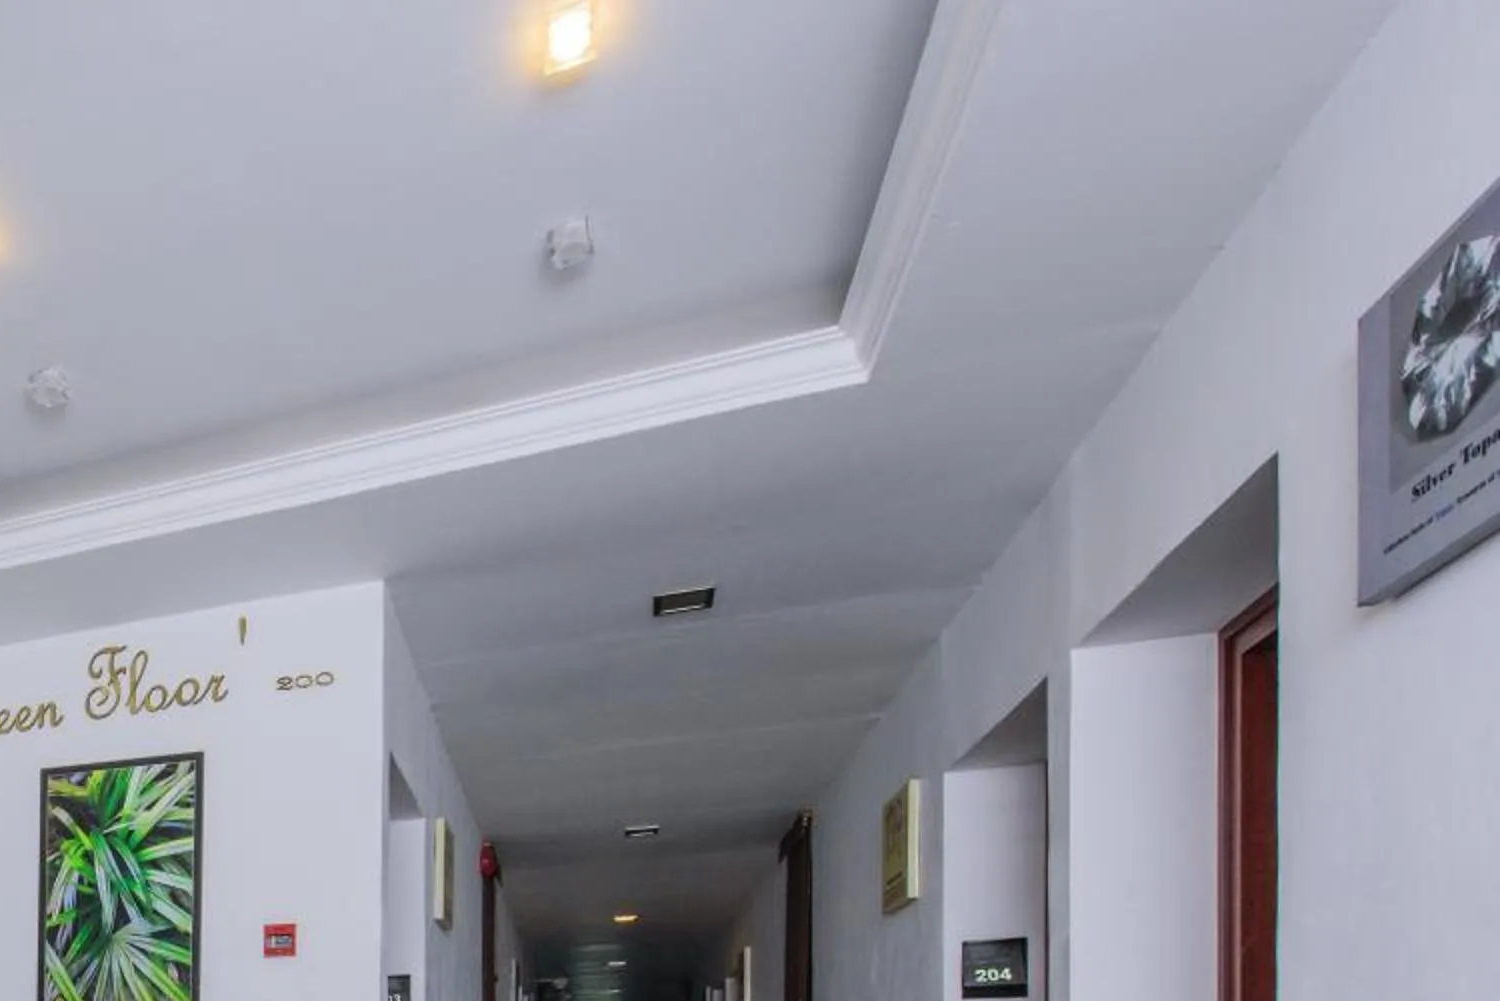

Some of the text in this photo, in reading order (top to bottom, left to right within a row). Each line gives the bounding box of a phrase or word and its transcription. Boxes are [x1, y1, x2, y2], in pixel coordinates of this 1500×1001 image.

[1411, 462, 1457, 503] Silver
[276, 671, 334, 691] 200
[975, 967, 1012, 982] 204
